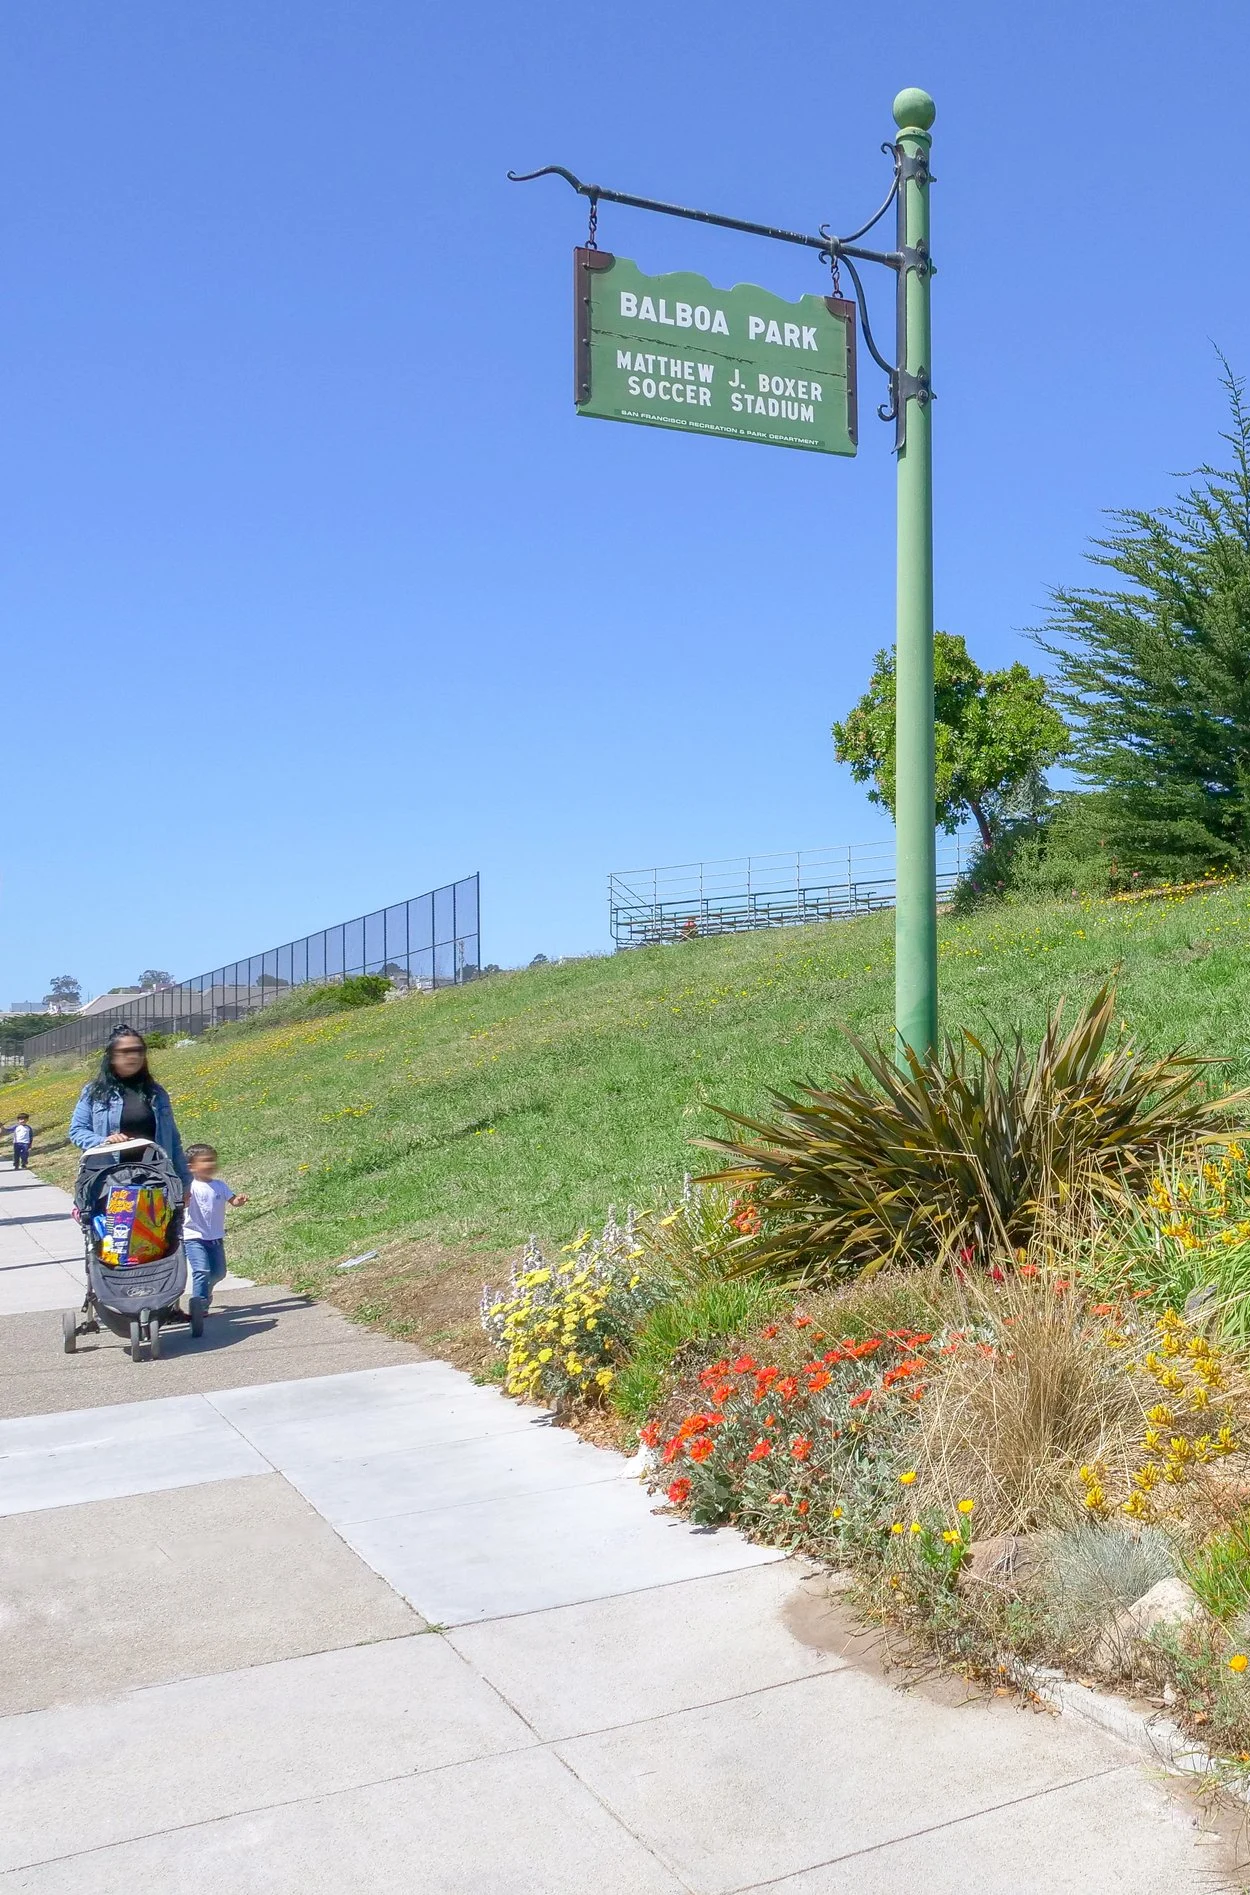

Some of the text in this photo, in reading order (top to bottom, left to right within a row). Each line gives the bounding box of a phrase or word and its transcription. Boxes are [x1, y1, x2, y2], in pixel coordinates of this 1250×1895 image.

[620, 291, 818, 351] BALBOA PARK
[616, 350, 822, 401] MATTHEW J. BOXER
[628, 376, 814, 423] SOCCER STADIUM
[621, 409, 639, 418] SAN
[640, 411, 687, 425] FRANCISCO
[688, 421, 738, 434] RECREATION
[746, 430, 767, 438] PARK
[769, 433, 819, 446] DEPARTMENT
